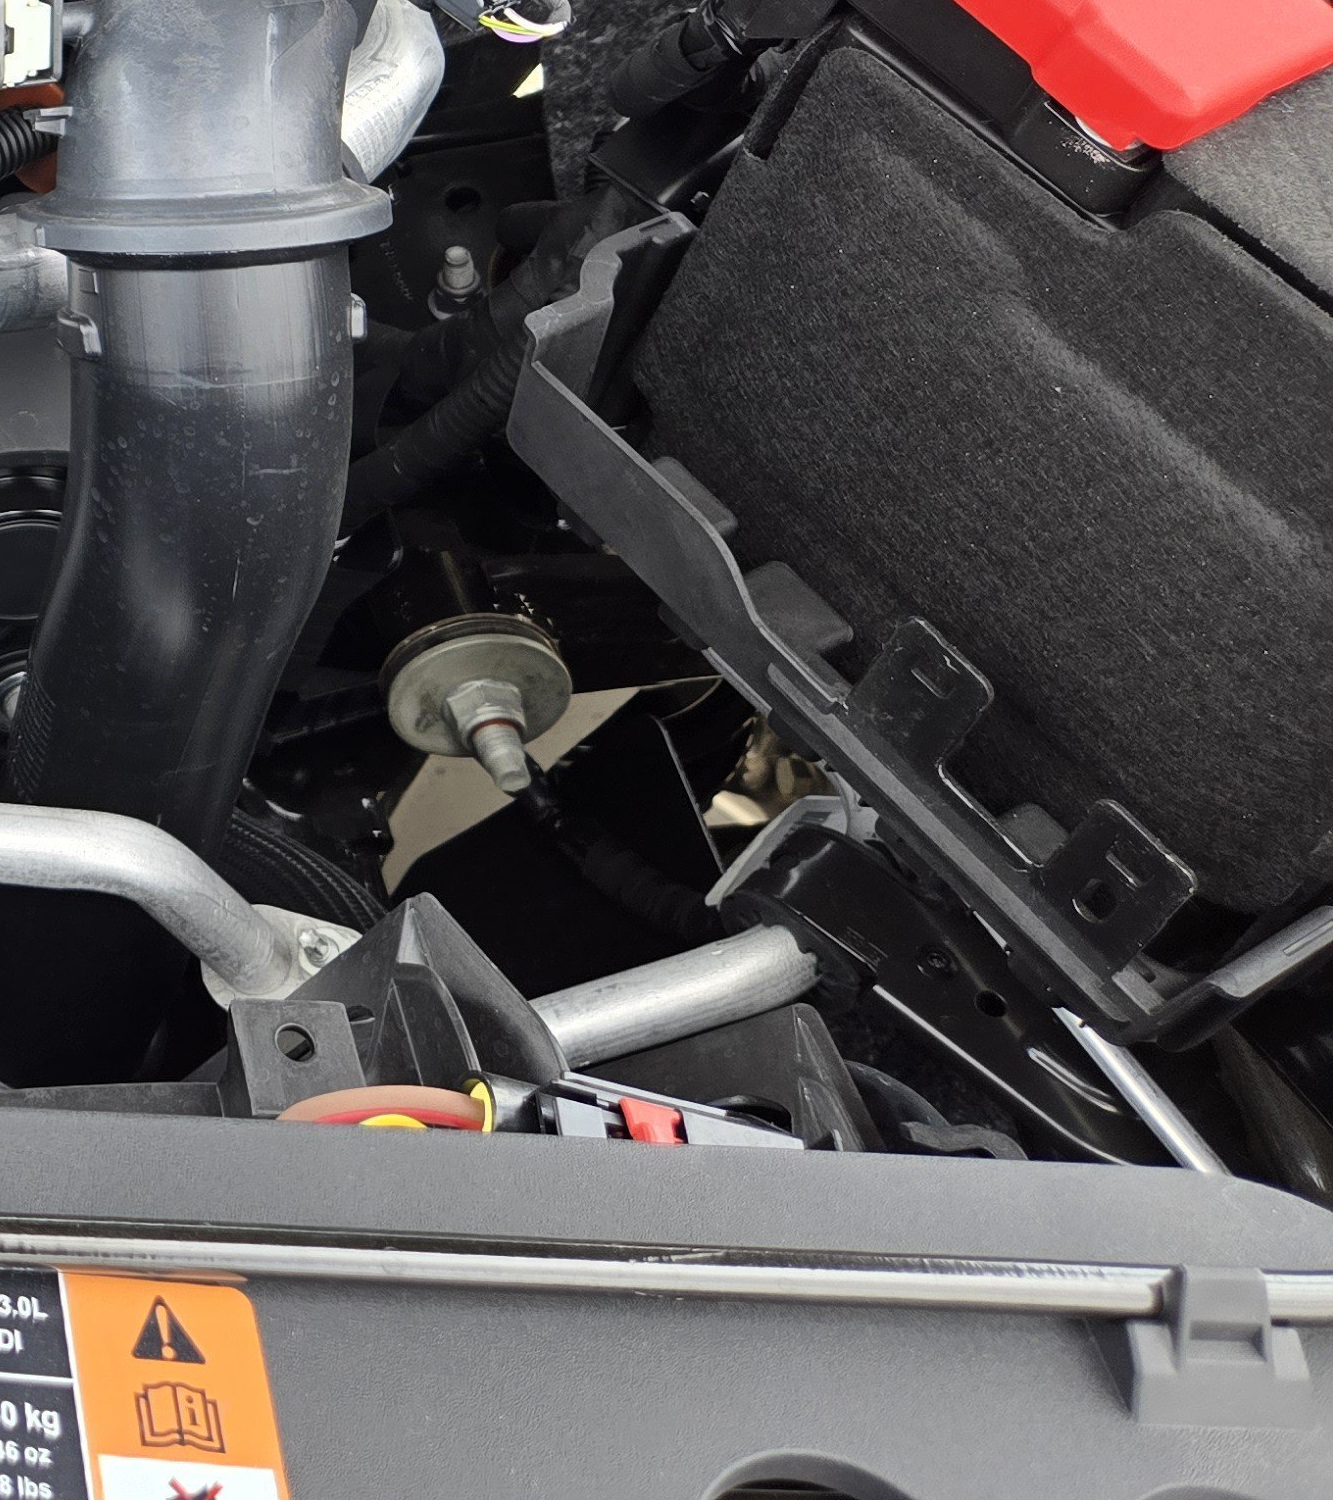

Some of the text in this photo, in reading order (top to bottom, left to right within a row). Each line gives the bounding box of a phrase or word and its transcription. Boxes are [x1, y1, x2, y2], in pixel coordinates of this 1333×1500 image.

[25, 1402, 62, 1440] kg
[24, 1447, 53, 1468] oz
[17, 1475, 54, 1500] lbs
